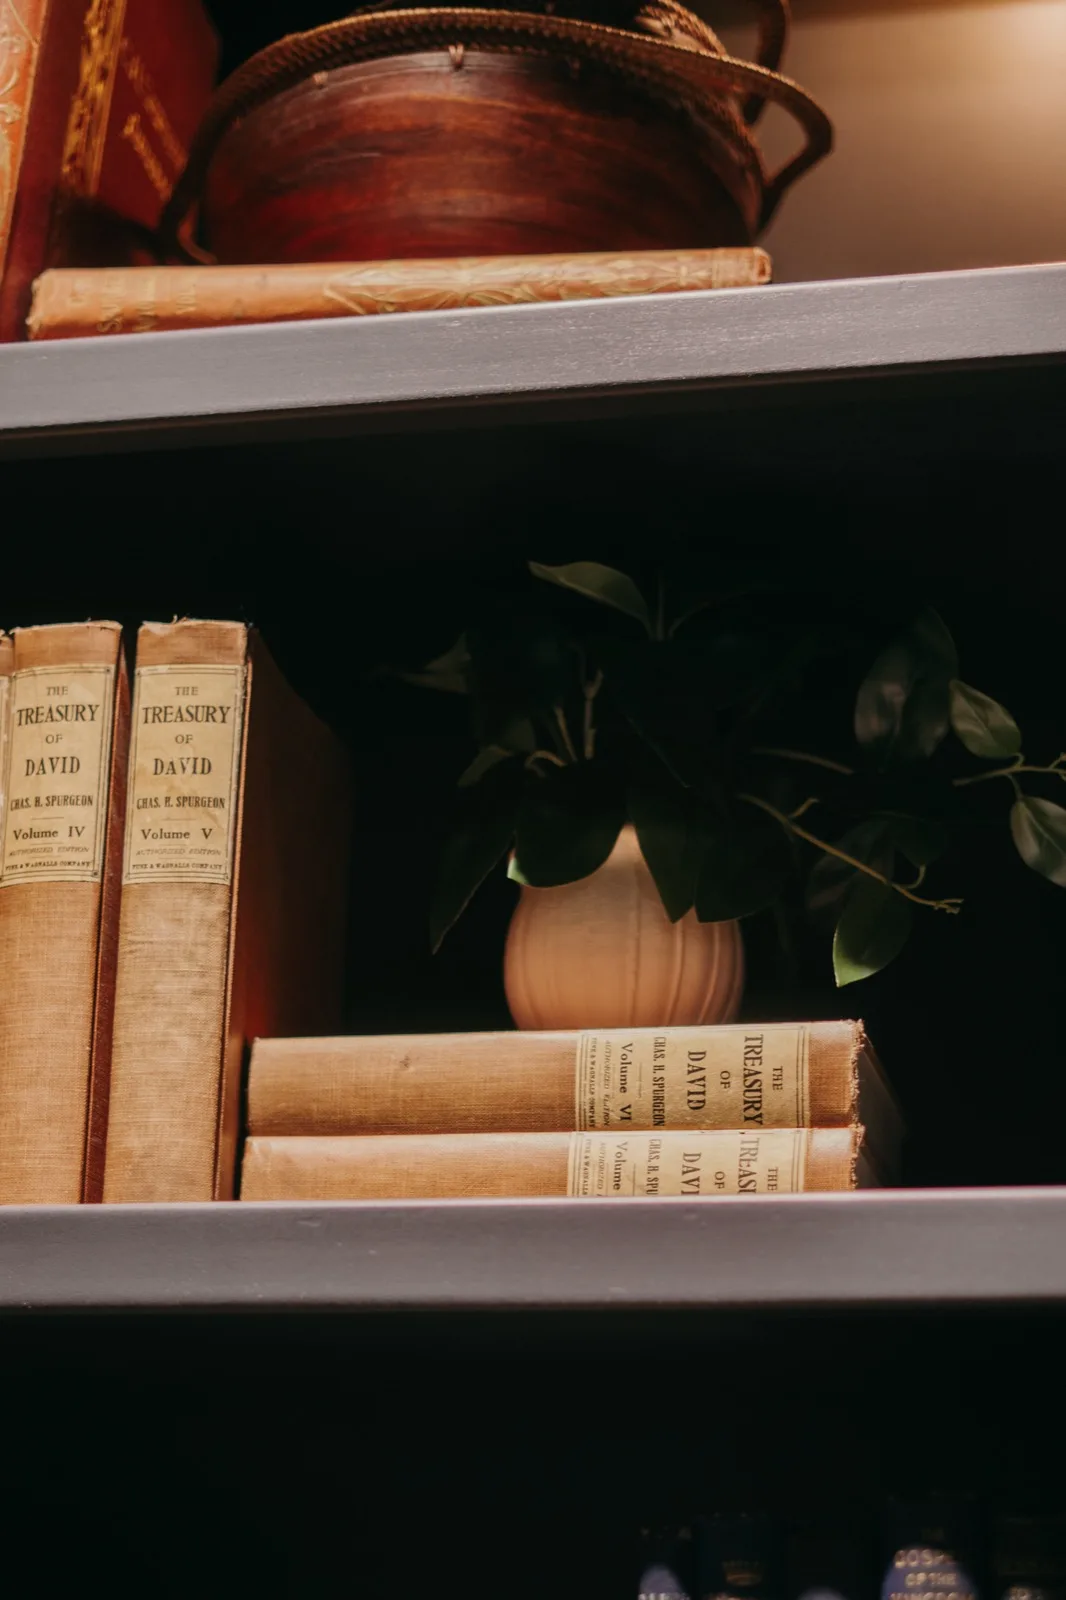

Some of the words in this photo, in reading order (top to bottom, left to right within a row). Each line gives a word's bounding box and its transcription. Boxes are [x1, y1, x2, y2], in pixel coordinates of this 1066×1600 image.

[46, 686, 69, 696] THE
[174, 686, 199, 696] THE
[16, 704, 100, 727] TREASURY
[142, 705, 231, 725] TREASURY
[45, 734, 63, 744] OF
[175, 734, 193, 744] OF
[25, 756, 81, 776] DAVID
[153, 757, 212, 775] DAVID
[10, 797, 31, 811] CHAS.
[45, 795, 93, 807] SPURGEON
[136, 797, 161, 810] CHAS.
[175, 796, 225, 809] SPURGEON
[13, 827, 58, 840] Volume
[68, 826, 85, 838] IV
[140, 828, 190, 840] Volume
[201, 828, 213, 840] V
[57, 845, 89, 853] EDITION
[653, 1036, 666, 1062] CHAS.
[619, 1043, 633, 1094] Volume
[652, 1065, 665, 1074] H.
[772, 1065, 783, 1091] THE
[686, 1050, 707, 1111] DAVID
[720, 1070, 731, 1089] OF
[743, 1034, 764, 1126] TREASURY
[652, 1076, 665, 1127] SPURGEON
[619, 1104, 633, 1121] VI
[648, 1139, 661, 1163] CHAS.
[613, 1141, 628, 1191] Volume
[680, 1152, 702, 1195] DAVI
[714, 1171, 725, 1189] OF
[767, 1167, 778, 1191] THE
